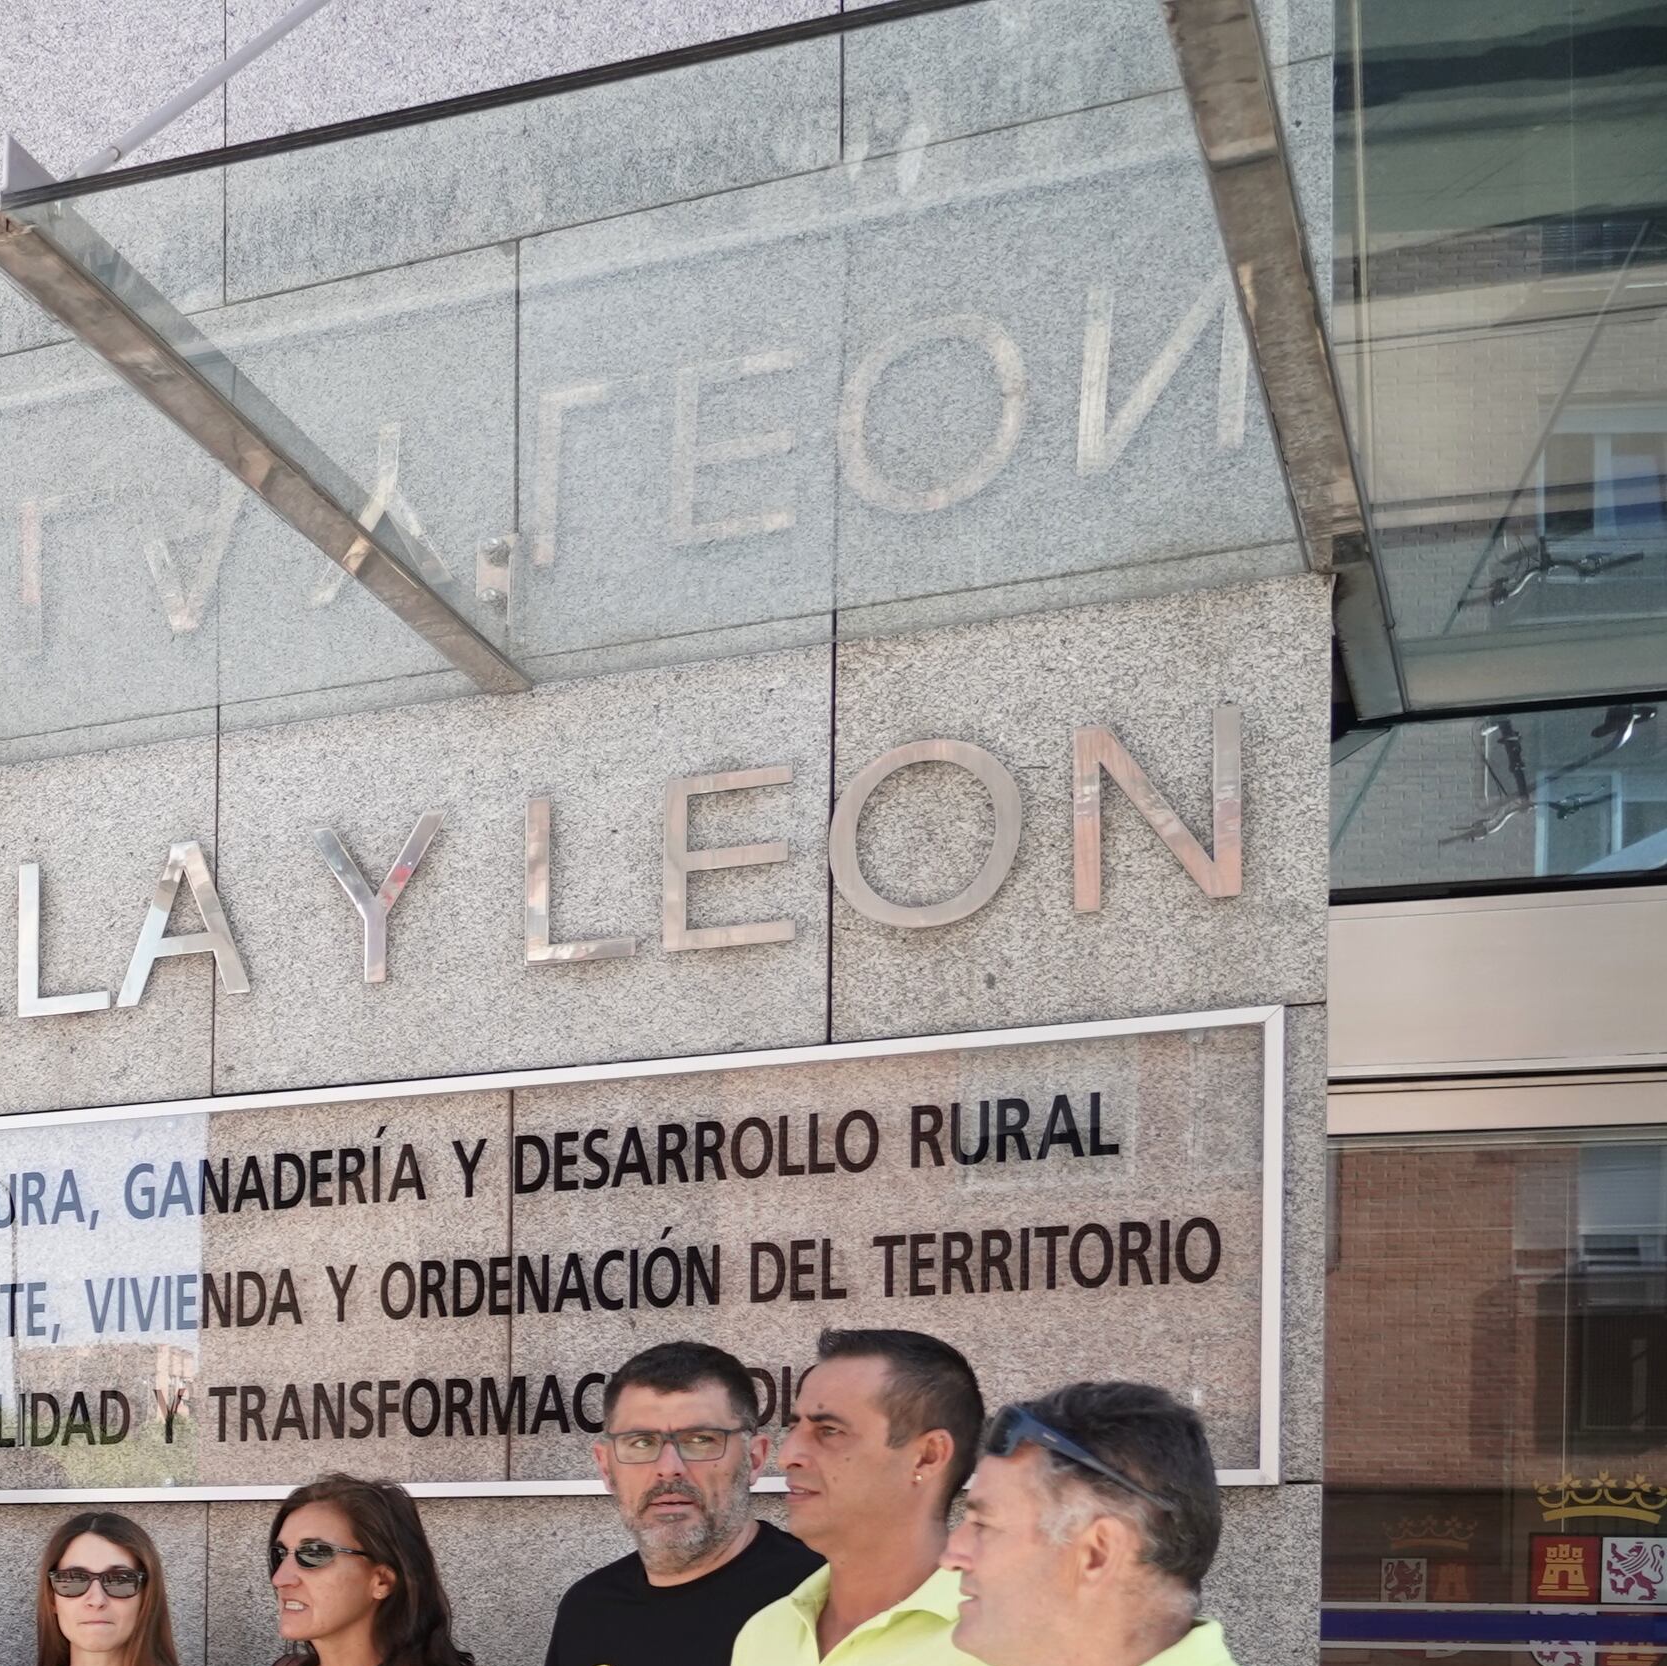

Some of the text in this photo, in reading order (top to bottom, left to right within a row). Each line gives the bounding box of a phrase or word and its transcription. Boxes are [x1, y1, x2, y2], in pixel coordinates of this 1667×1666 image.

[309, 811, 447, 984] Y
[523, 703, 1243, 968] LEON
[124, 1127, 427, 1220] GANADERÍA
[454, 1138, 488, 1199] Y
[513, 1108, 881, 1196] DESARROLLO
[909, 1092, 1120, 1169] RURAL
[84, 1267, 303, 1335] VIVIENDA
[325, 1264, 359, 1323] Y
[380, 1227, 722, 1322] ORDENACIÓN
[749, 1238, 848, 1305] DEL
[873, 1216, 1223, 1298] TERRITORIO
[153, 1389, 187, 1446] Y
[209, 1372, 606, 1444] TRANSFORMAC
